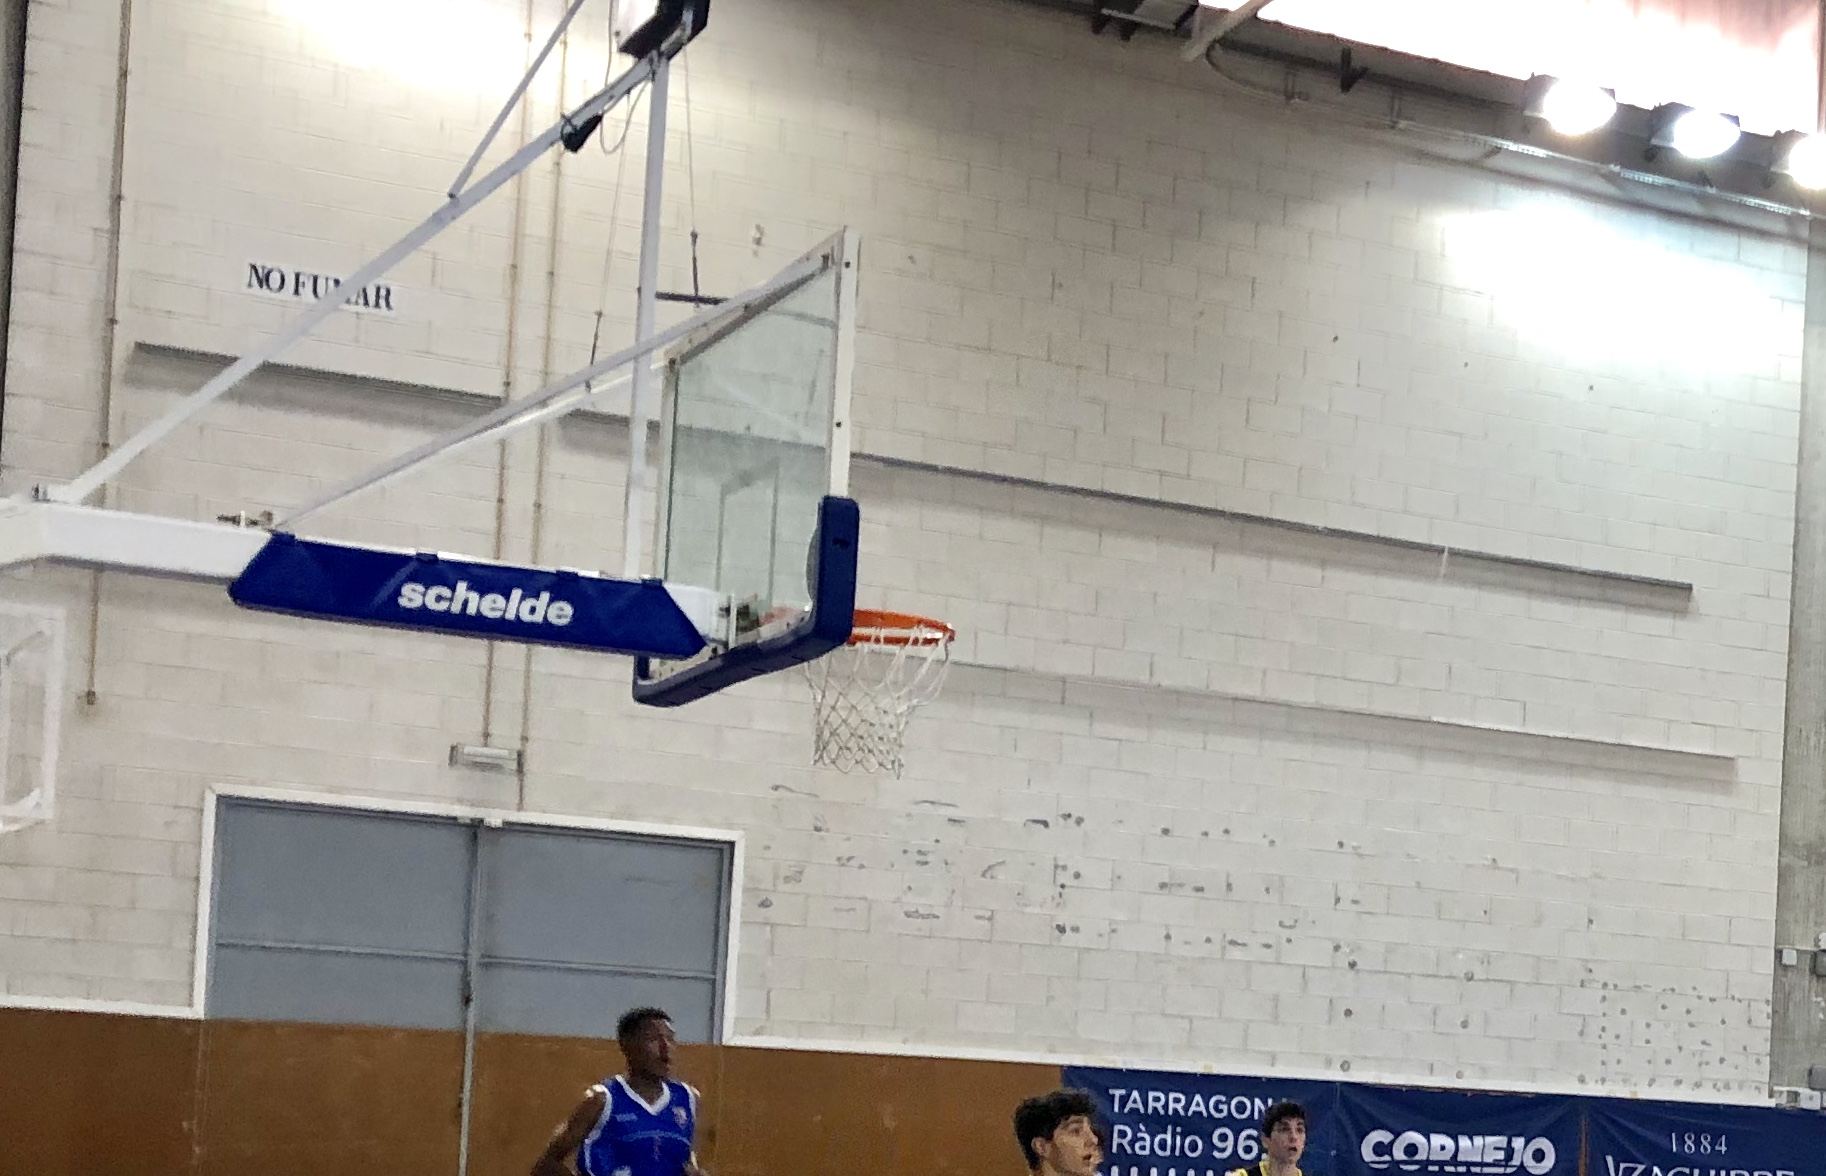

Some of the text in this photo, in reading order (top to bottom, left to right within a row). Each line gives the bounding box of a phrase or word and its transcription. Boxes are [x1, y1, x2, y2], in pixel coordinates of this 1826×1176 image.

[248, 262, 393, 311] NO FUAR
[398, 580, 574, 626] schelde
[1109, 1088, 1287, 1121] TARRAGON
[1111, 1123, 1203, 1158] Ràdio
[1361, 1129, 1556, 1175] CORNEJO
[1671, 1132, 1727, 1155] 1884
